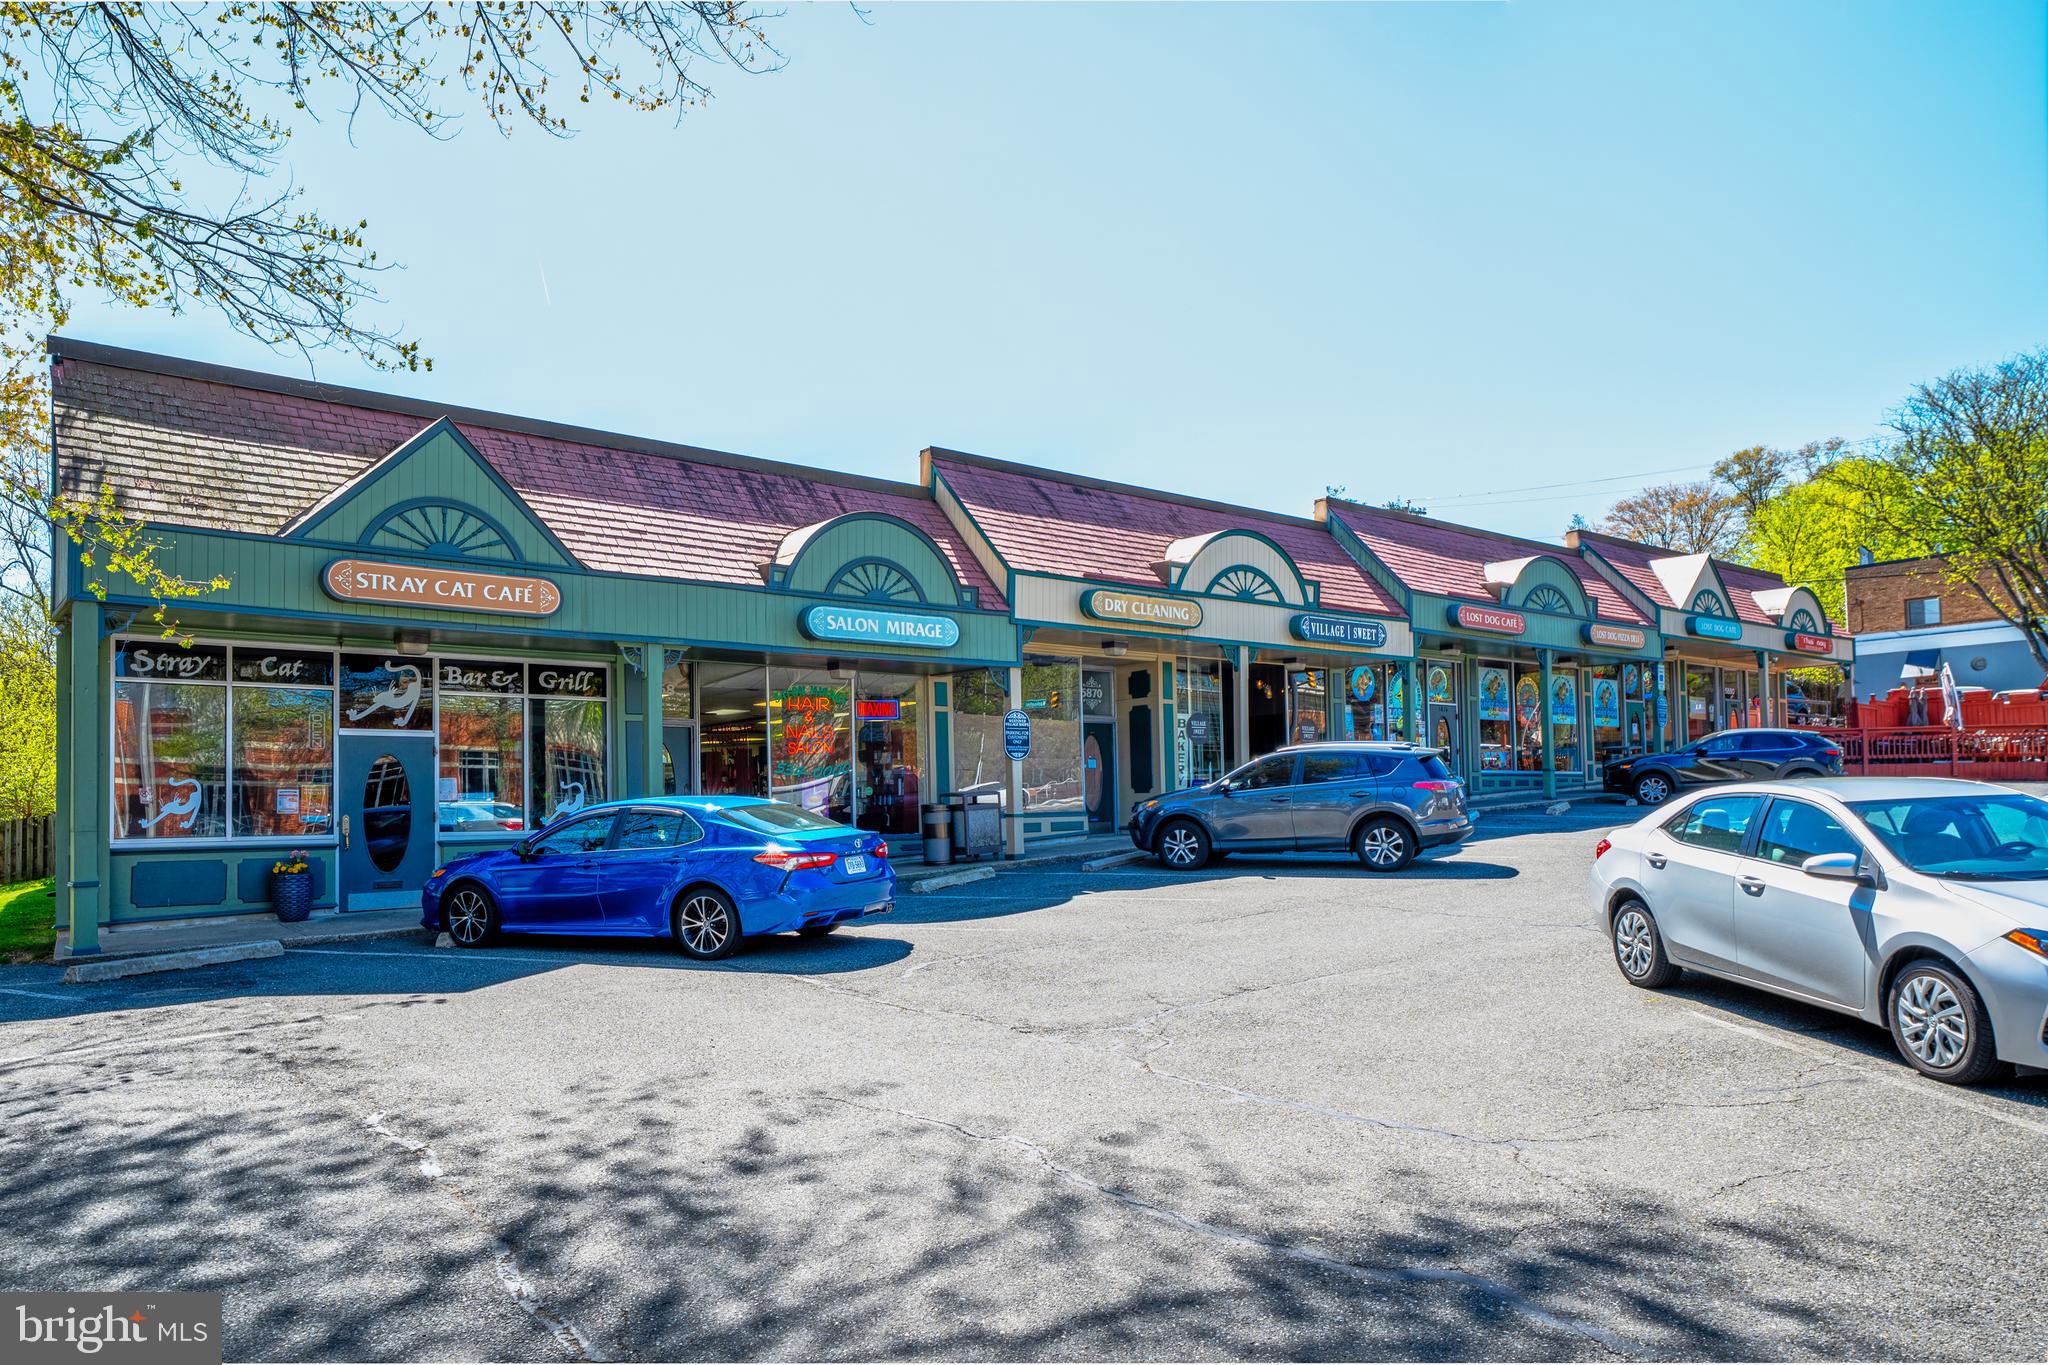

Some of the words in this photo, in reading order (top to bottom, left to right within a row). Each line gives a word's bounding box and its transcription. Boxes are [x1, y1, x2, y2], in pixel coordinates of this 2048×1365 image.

[356, 572, 428, 594] STRAY
[434, 580, 476, 598] CAT
[483, 584, 534, 604] CAFÉ
[1104, 598, 1128, 613] DRY
[1131, 601, 1190, 620] CLEANING
[826, 615, 879, 633] SALON
[886, 620, 943, 638] MIRAGE
[1466, 612, 1483, 623] LOST
[1484, 615, 1501, 626] DOG
[1311, 622, 1345, 638] VILLAGE
[1353, 627, 1377, 641] SWEET
[1597, 630, 1607, 639] LOST
[130, 650, 211, 677] Stray
[257, 656, 303, 677] Cat
[443, 666, 488, 687] Bar
[491, 670, 518, 687] &
[538, 671, 594, 691] Grill
[787, 696, 831, 712] HAIR
[857, 701, 897, 717] WAXING
[804, 710, 815, 723] &
[311, 713, 323, 749] OPEN
[785, 724, 834, 740] NAILS
[787, 741, 834, 755] SALON
[1177, 718, 1187, 786] BAKERY
